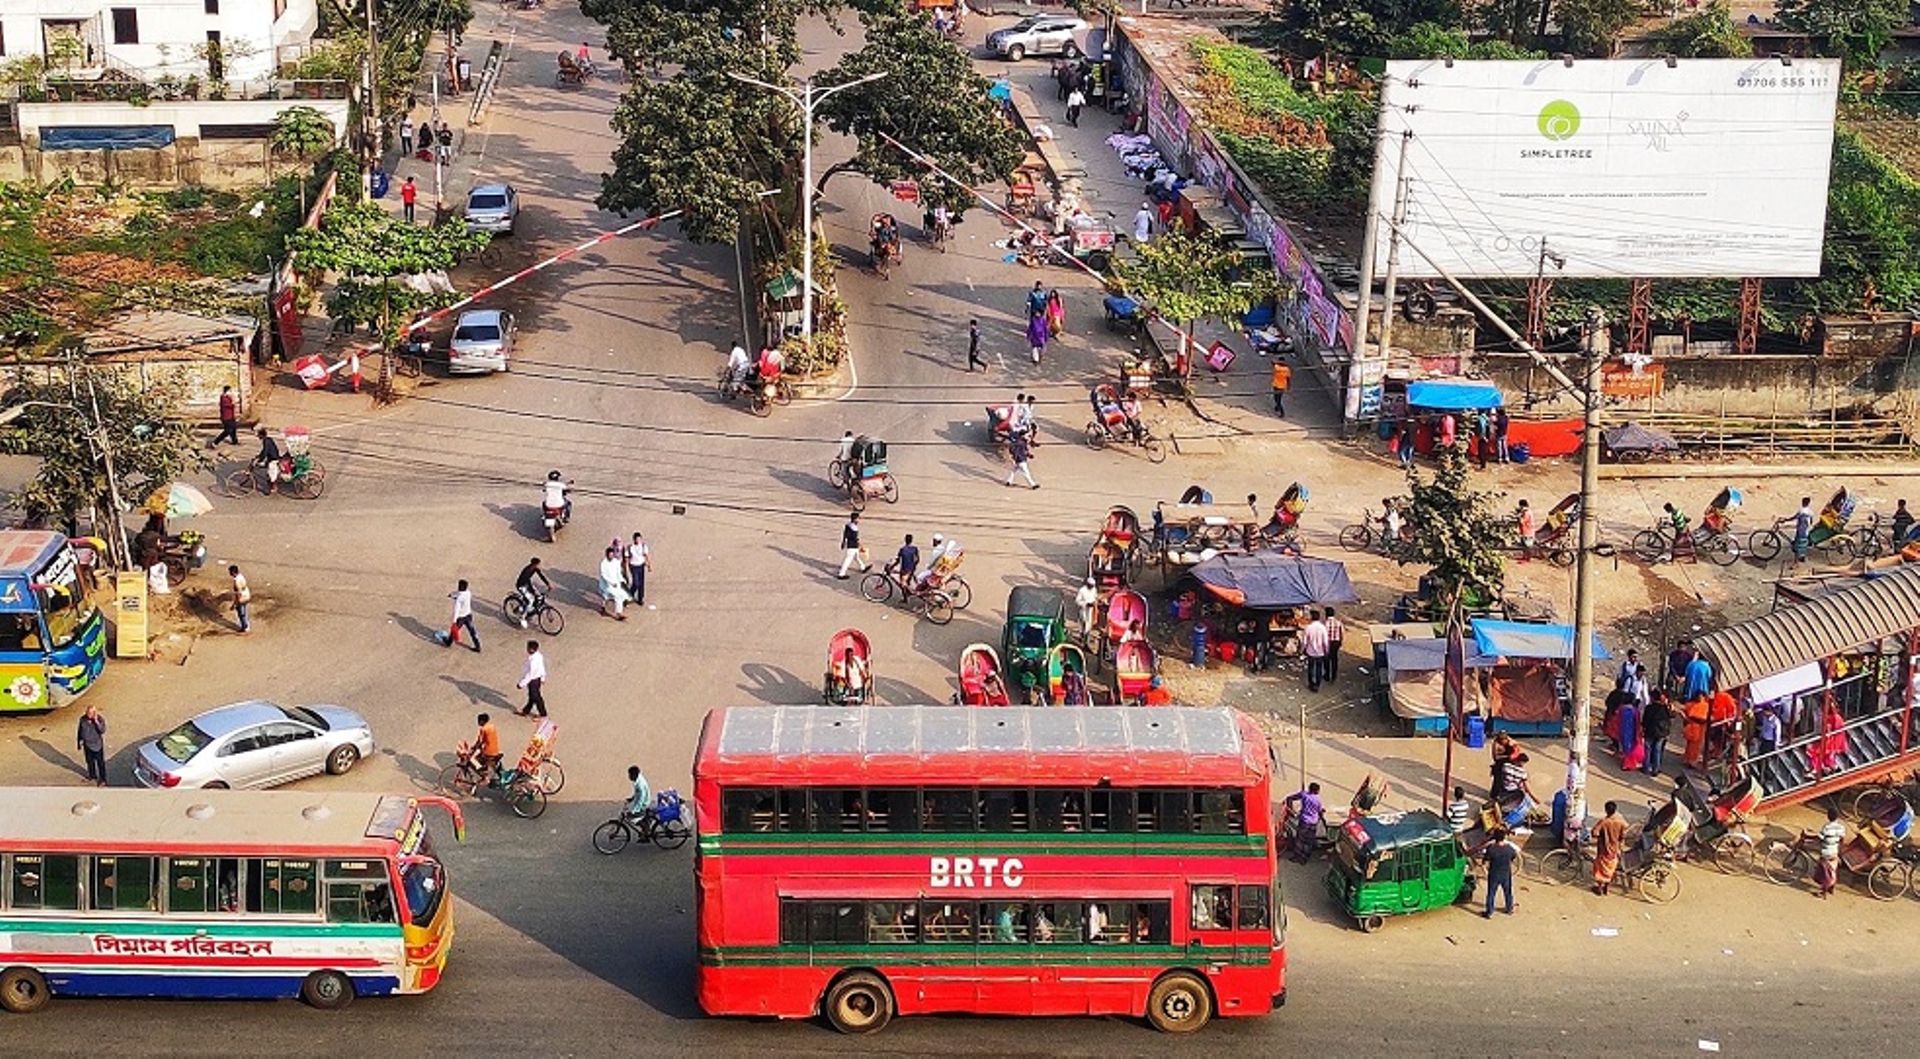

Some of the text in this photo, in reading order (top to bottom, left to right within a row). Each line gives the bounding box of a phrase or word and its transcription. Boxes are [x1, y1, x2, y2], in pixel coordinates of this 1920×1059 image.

[1737, 77, 1776, 87] 01706
[1781, 76, 1805, 87] 555
[1520, 149, 1593, 159] SIMPLETREE
[930, 857, 1024, 888] BRTC
[95, 933, 167, 956] সিয়াম
[170, 935, 273, 957] পরিবহন
